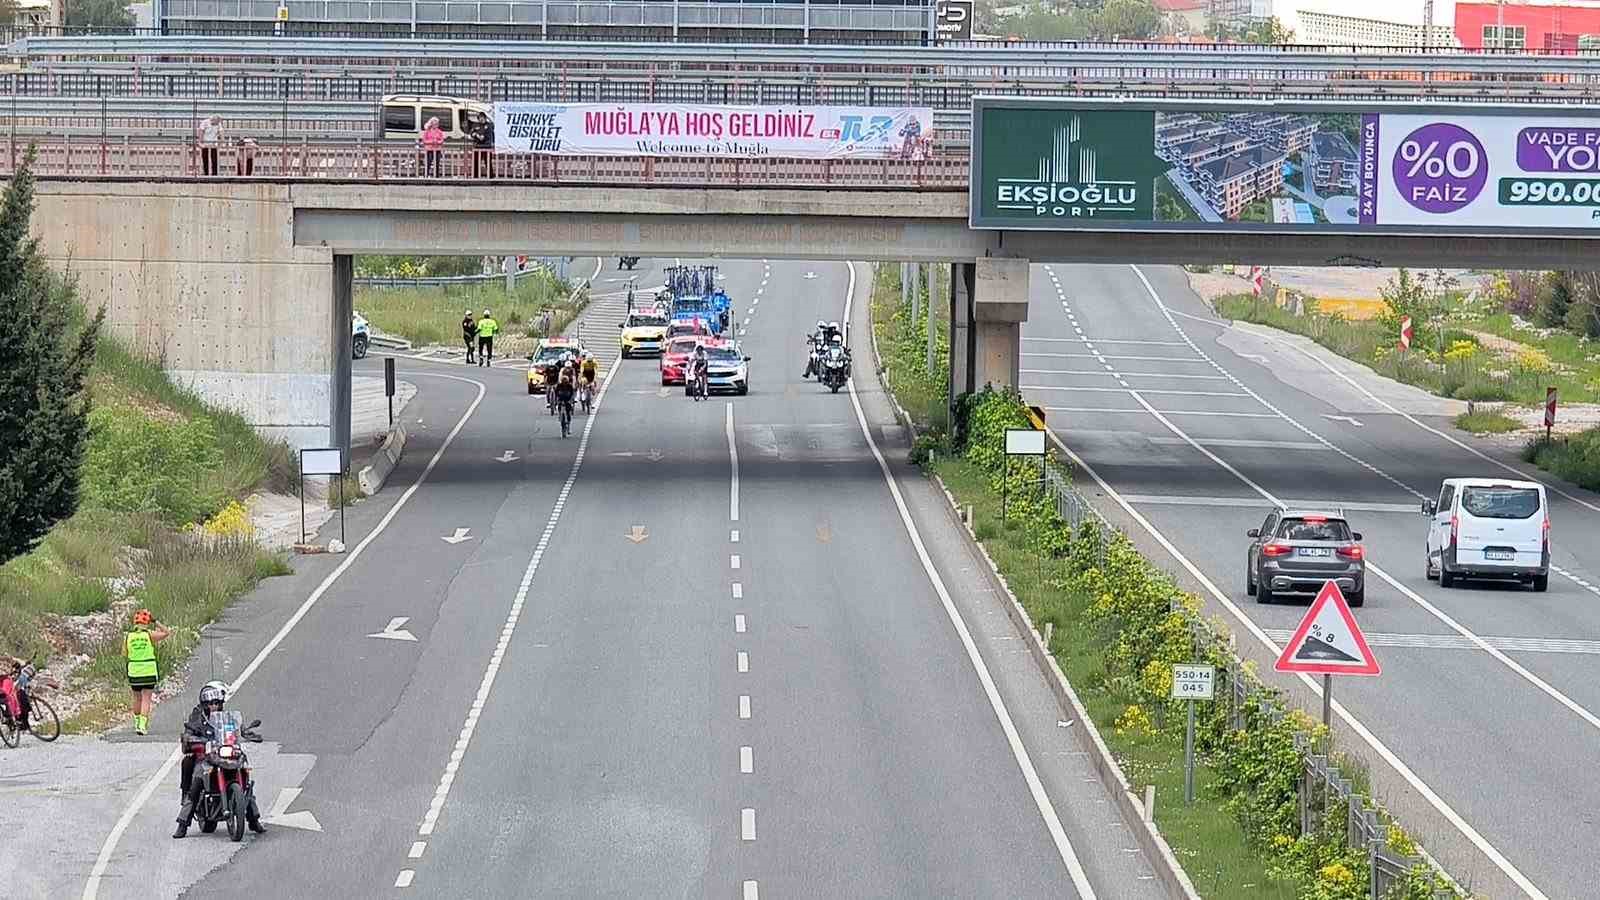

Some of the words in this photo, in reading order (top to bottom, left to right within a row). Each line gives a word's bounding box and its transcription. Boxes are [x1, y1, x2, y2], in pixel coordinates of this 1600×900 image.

[686, 112, 723, 141] HOŞ
[730, 109, 815, 138] GELDİNİZ
[637, 140, 702, 153] Welcome
[706, 146, 720, 154] to
[1526, 132, 1578, 146] VADE
[1364, 122, 1376, 179] BOYUNCA
[1400, 140, 1479, 179] %0
[1544, 145, 1600, 171] YO
[997, 183, 1136, 205] EKŞİOĞLU
[1363, 182, 1374, 198] AY
[1413, 183, 1467, 202] FAİZ
[1037, 206, 1097, 217] PORT
